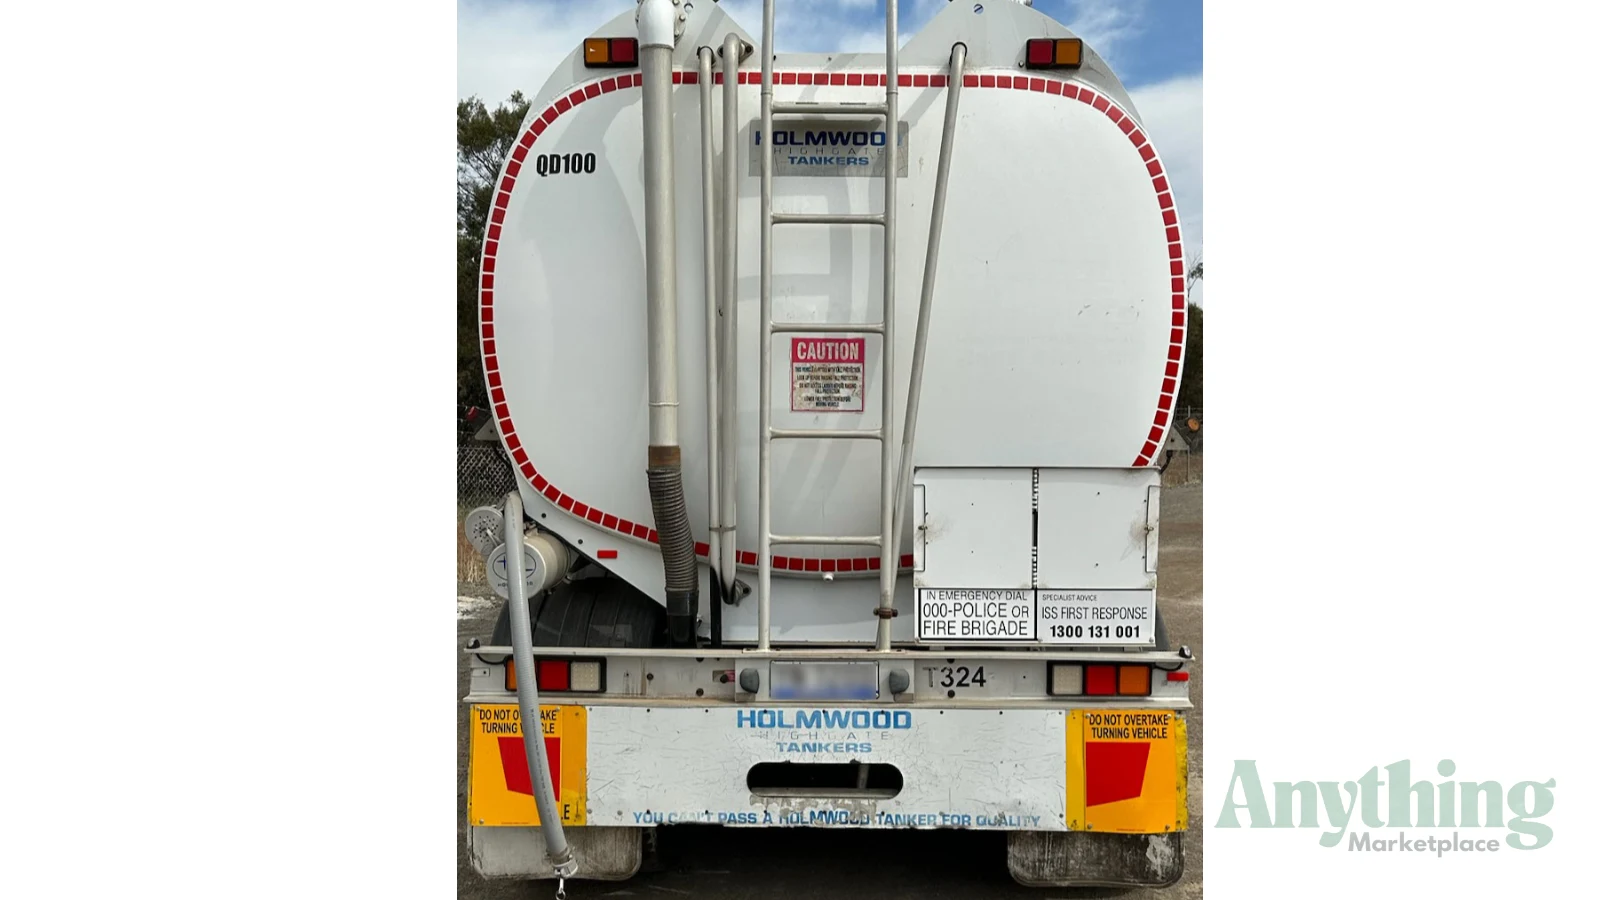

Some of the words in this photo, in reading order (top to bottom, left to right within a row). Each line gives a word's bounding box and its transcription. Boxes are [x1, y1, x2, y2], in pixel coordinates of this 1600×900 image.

[755, 131, 903, 146] OLMWOO
[774, 147, 884, 155] HIGHGATE
[536, 153, 596, 177] QD100
[788, 156, 869, 166] TANKERS
[797, 342, 859, 360] CAUTION
[926, 590, 935, 601] IN
[939, 590, 1003, 601] EMERGENCY
[1005, 590, 1027, 600] DIAL
[1076, 594, 1098, 602] ADVICE
[923, 602, 1008, 618] 000-POLICE
[1011, 606, 1029, 618] OR
[1042, 607, 1058, 620] ISS
[1061, 607, 1089, 620] FIRST
[1092, 607, 1148, 620] RESPONSE
[923, 620, 956, 636] FIRE
[961, 620, 1028, 636] BRIGADE
[1050, 625, 1083, 638] 1300
[1088, 625, 1112, 638] 131
[1115, 625, 1140, 638] 001
[923, 666, 987, 688] T324
[479, 709, 492, 720] DO
[494, 709, 511, 720] NOT
[512, 709, 557, 721] OAKE
[737, 709, 912, 729] HOLMWOOD
[1089, 714, 1102, 725] DO
[1104, 714, 1121, 725] NOT
[1124, 714, 1168, 725] OVERTAKE
[481, 722, 518, 734] TURNING
[1091, 727, 1130, 739] TURNING
[1132, 727, 1168, 739] VEHICLE
[776, 742, 872, 753] TANKERS
[633, 811, 663, 824] YOU
[718, 812, 757, 824] PASS
[762, 812, 773, 824] A
[876, 813, 938, 826] TANKER
[941, 813, 971, 826] FOR
[976, 814, 1041, 827] QUALITY
